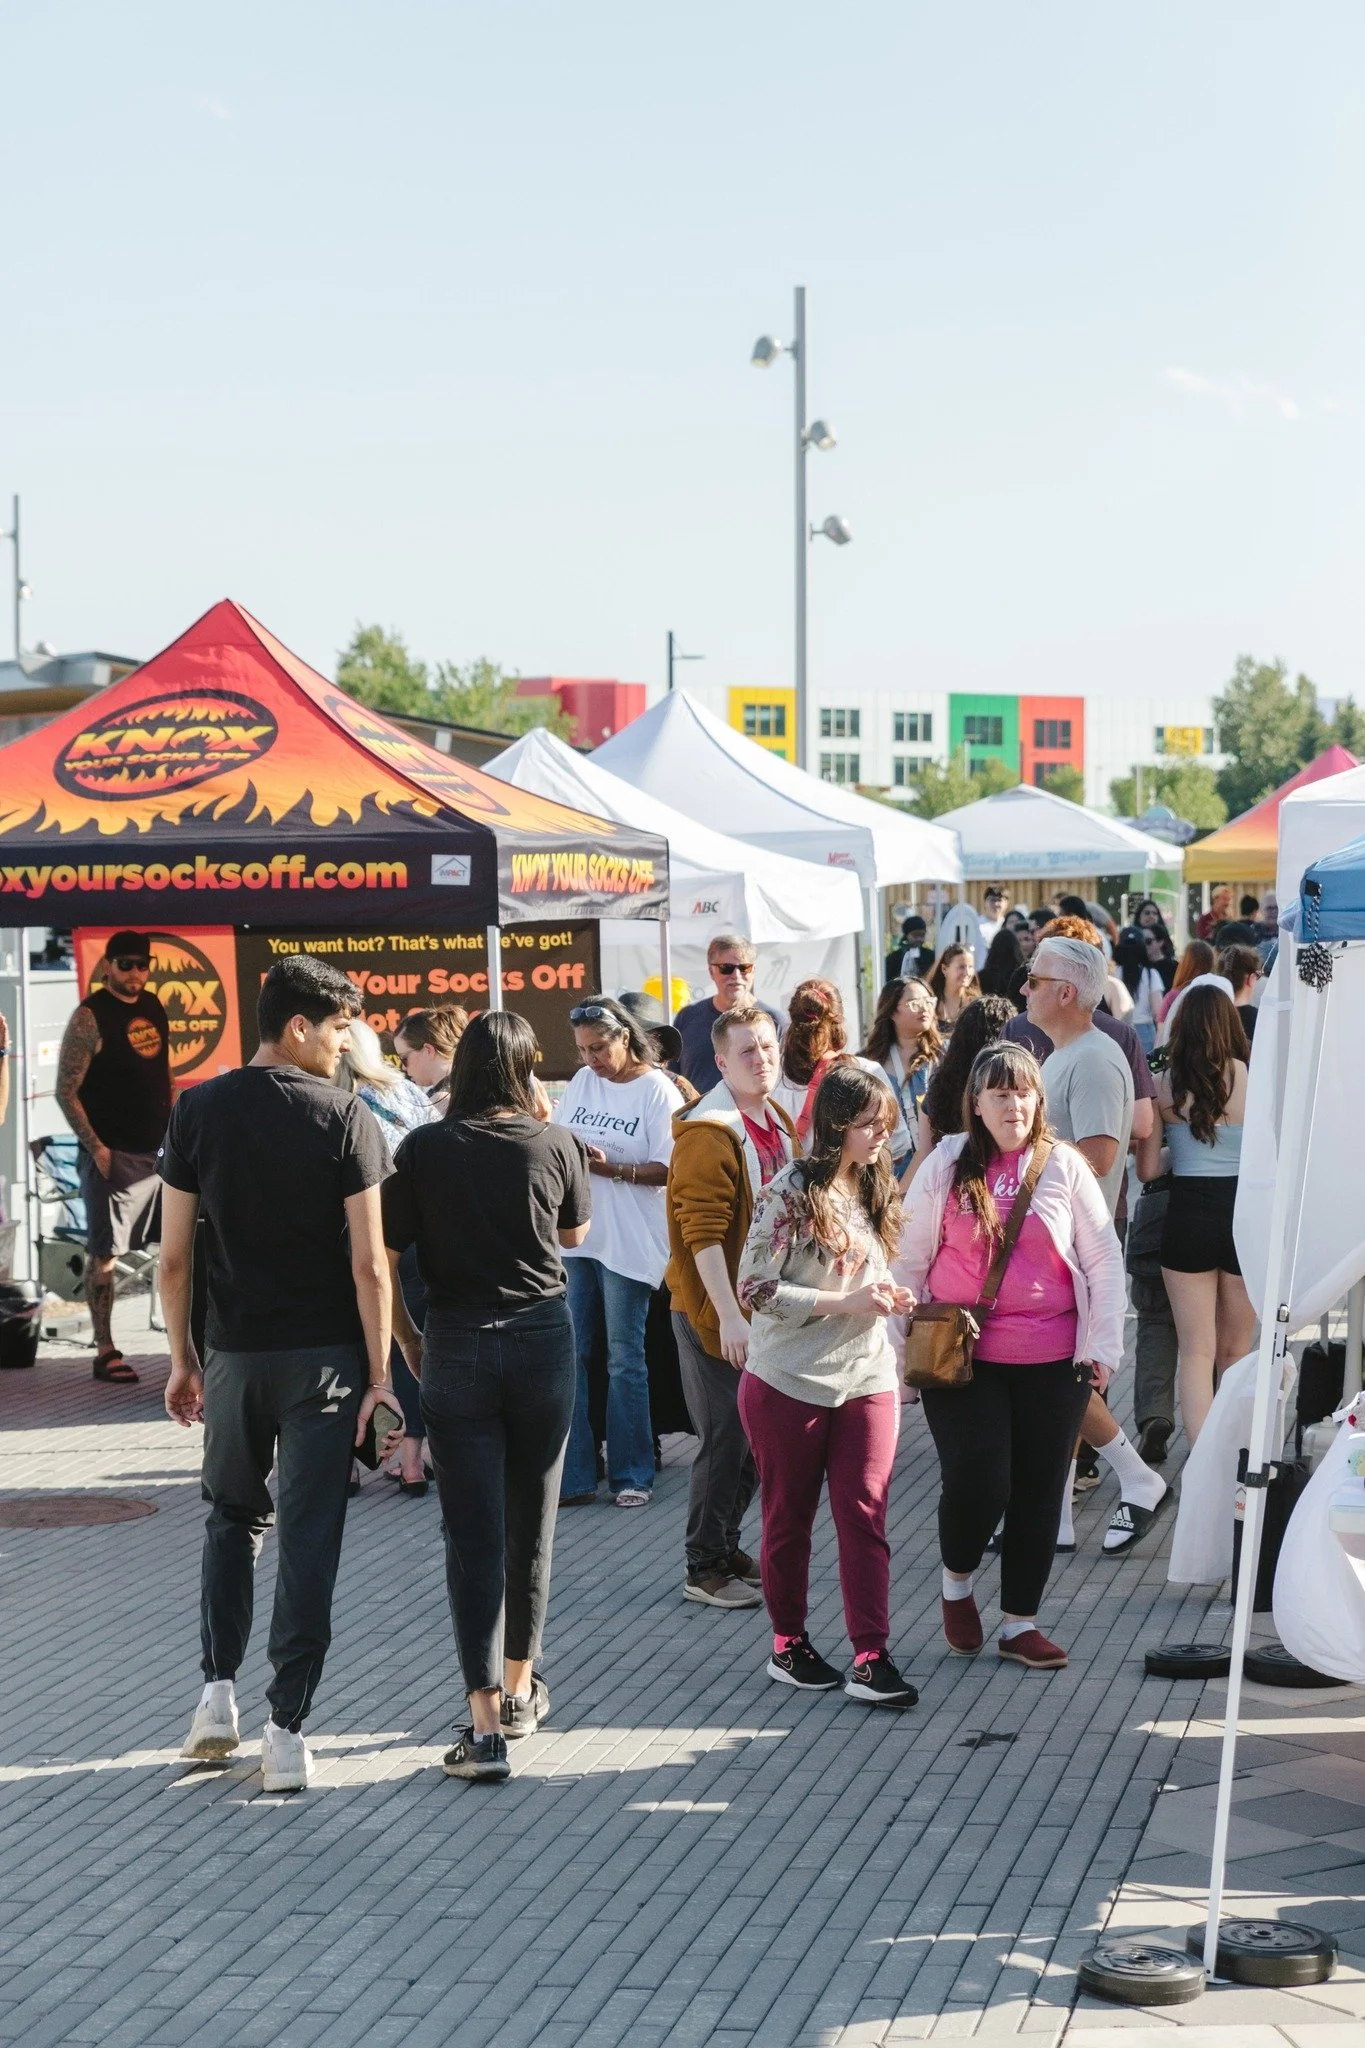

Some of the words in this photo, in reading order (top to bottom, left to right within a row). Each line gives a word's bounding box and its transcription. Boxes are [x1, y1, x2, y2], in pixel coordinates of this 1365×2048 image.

[66, 725, 274, 760] KNOX
[63, 755, 124, 772] YOUR
[125, 752, 201, 765] SOCKS
[203, 751, 251, 762] OFF
[0, 855, 408, 899] xyoursocksoff.com
[511, 853, 550, 893] KNOX
[551, 852, 589, 892] YOUR
[588, 853, 630, 893] SOCKS
[628, 859, 656, 894] OFF
[691, 900, 719, 913] ABC
[268, 938, 300, 953] You
[303, 937, 344, 953] want
[347, 936, 385, 952] hot?
[388, 935, 439, 951] That's
[443, 934, 484, 950] what
[500, 932, 534, 948] e've
[539, 931, 573, 950] got!
[346, 970, 422, 995] Your
[531, 963, 585, 991] Off
[189, 1020, 218, 1032] OFF
[568, 1106, 640, 1137] Retired
